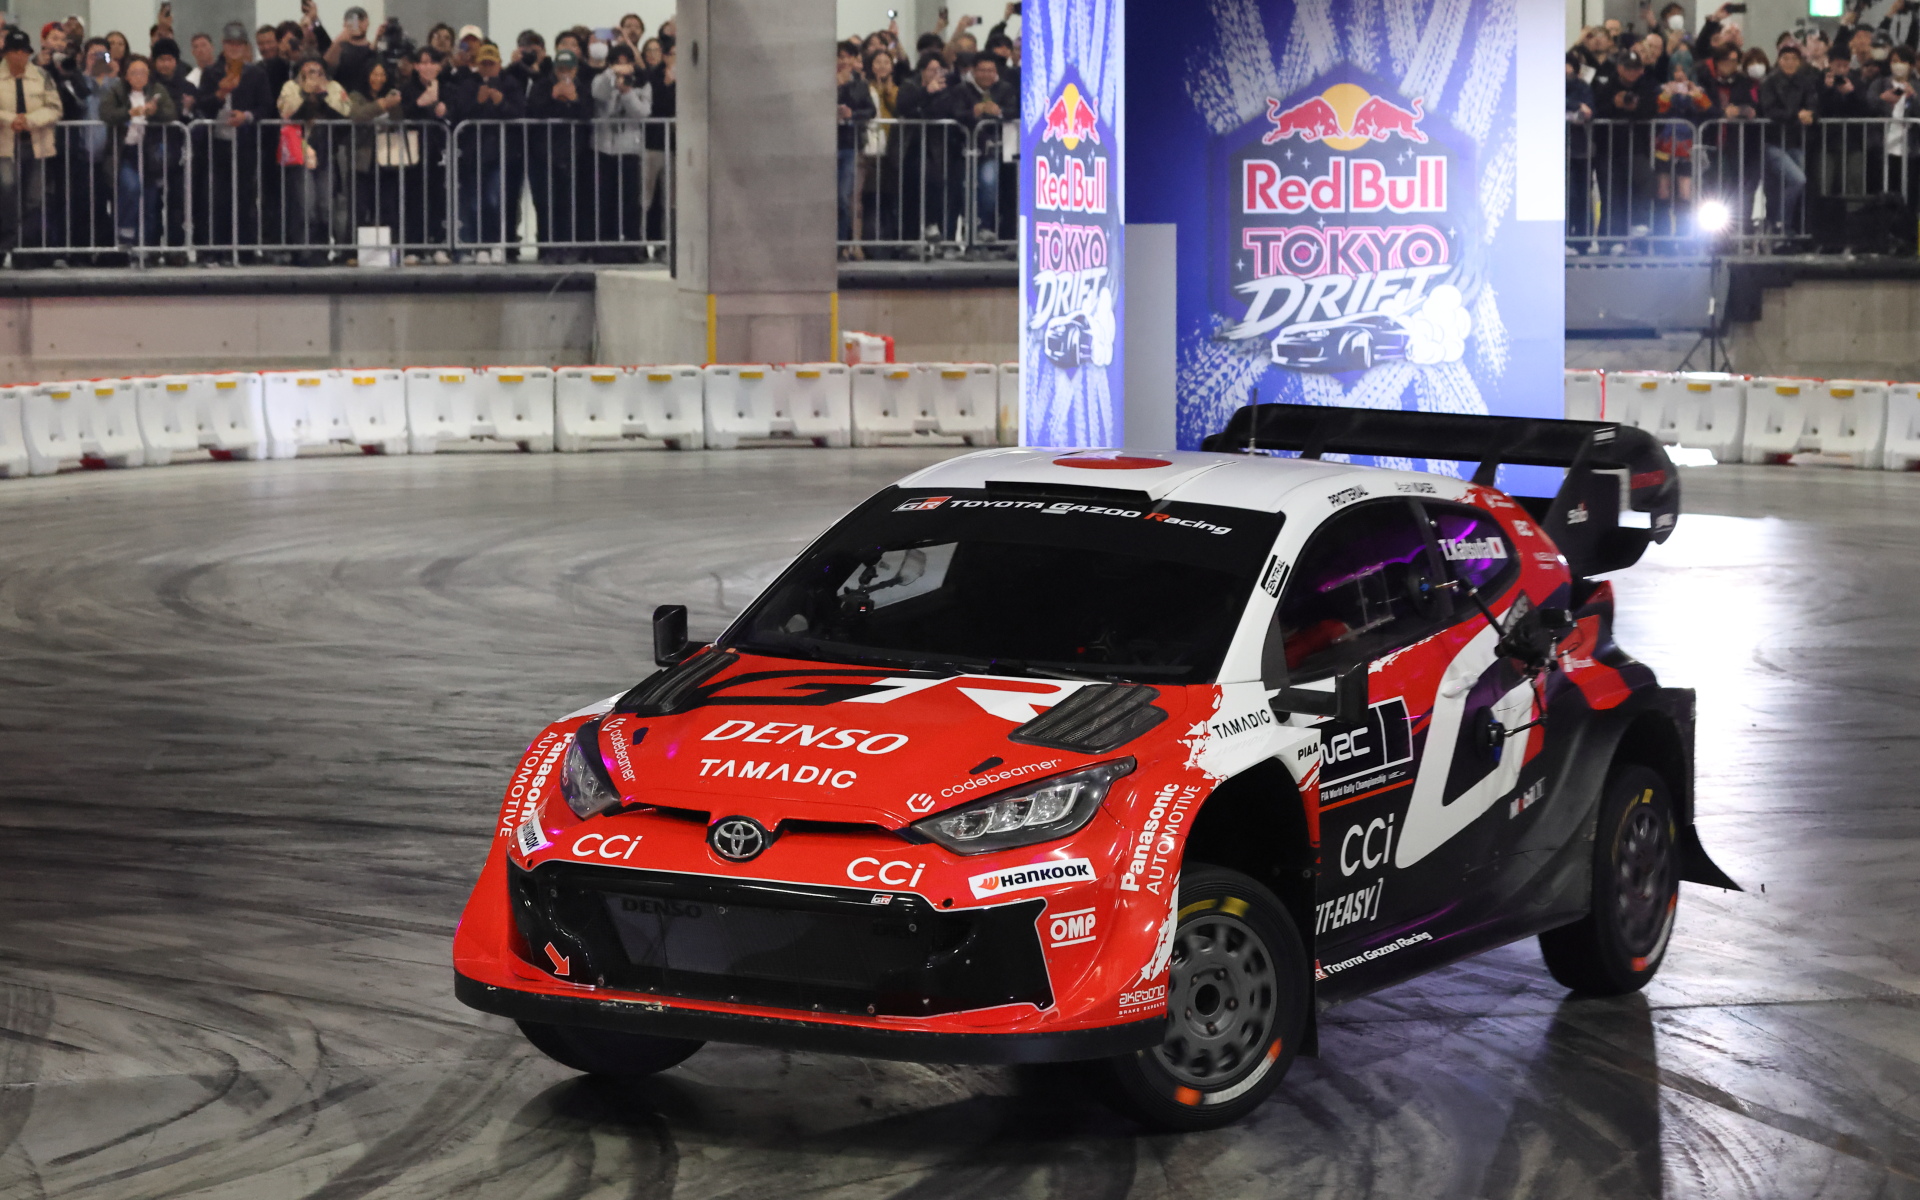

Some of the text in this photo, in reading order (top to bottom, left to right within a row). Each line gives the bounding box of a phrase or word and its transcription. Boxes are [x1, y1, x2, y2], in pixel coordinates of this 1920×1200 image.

[1036, 155, 1107, 213] Red Bull
[1243, 156, 1447, 214] Red Bull
[1036, 222, 1108, 272] TOKYO
[1243, 225, 1449, 279] TOKYO
[1029, 267, 1108, 329] DRIFT
[1222, 264, 1452, 339] DRIFT
[897, 497, 1233, 535] GR TOYOTA GAZOO Racing
[1265, 560, 1286, 596] CENTRAL
[700, 719, 909, 755] DENSO
[1212, 709, 1271, 739] TAMADIC
[1298, 742, 1319, 761] PIAA
[500, 731, 558, 838] AUTOMOTIVE
[519, 732, 576, 823] Panasoni
[699, 758, 858, 788] TAMADIC
[940, 757, 1062, 799] codebeamer
[1320, 791, 1329, 801] FIA
[1329, 787, 1343, 799] World
[1343, 783, 1355, 795] Rally
[1355, 773, 1387, 790] Championship
[571, 833, 644, 860] CCi
[1120, 783, 1180, 892] Panasonic
[1146, 785, 1202, 896] AUTOMOTIVE
[1340, 812, 1395, 877] CCi
[846, 857, 926, 888] CCi
[621, 899, 702, 919] DENSO
[1050, 913, 1096, 941] OMP
[1315, 877, 1384, 936] IT-EASY]
[1323, 956, 1366, 974] TOYOTA
[1363, 944, 1400, 961] GAZOO
[1396, 931, 1434, 948] Racing
[1119, 984, 1165, 1005] akebono
[1143, 1001, 1166, 1011] EXPERTS
